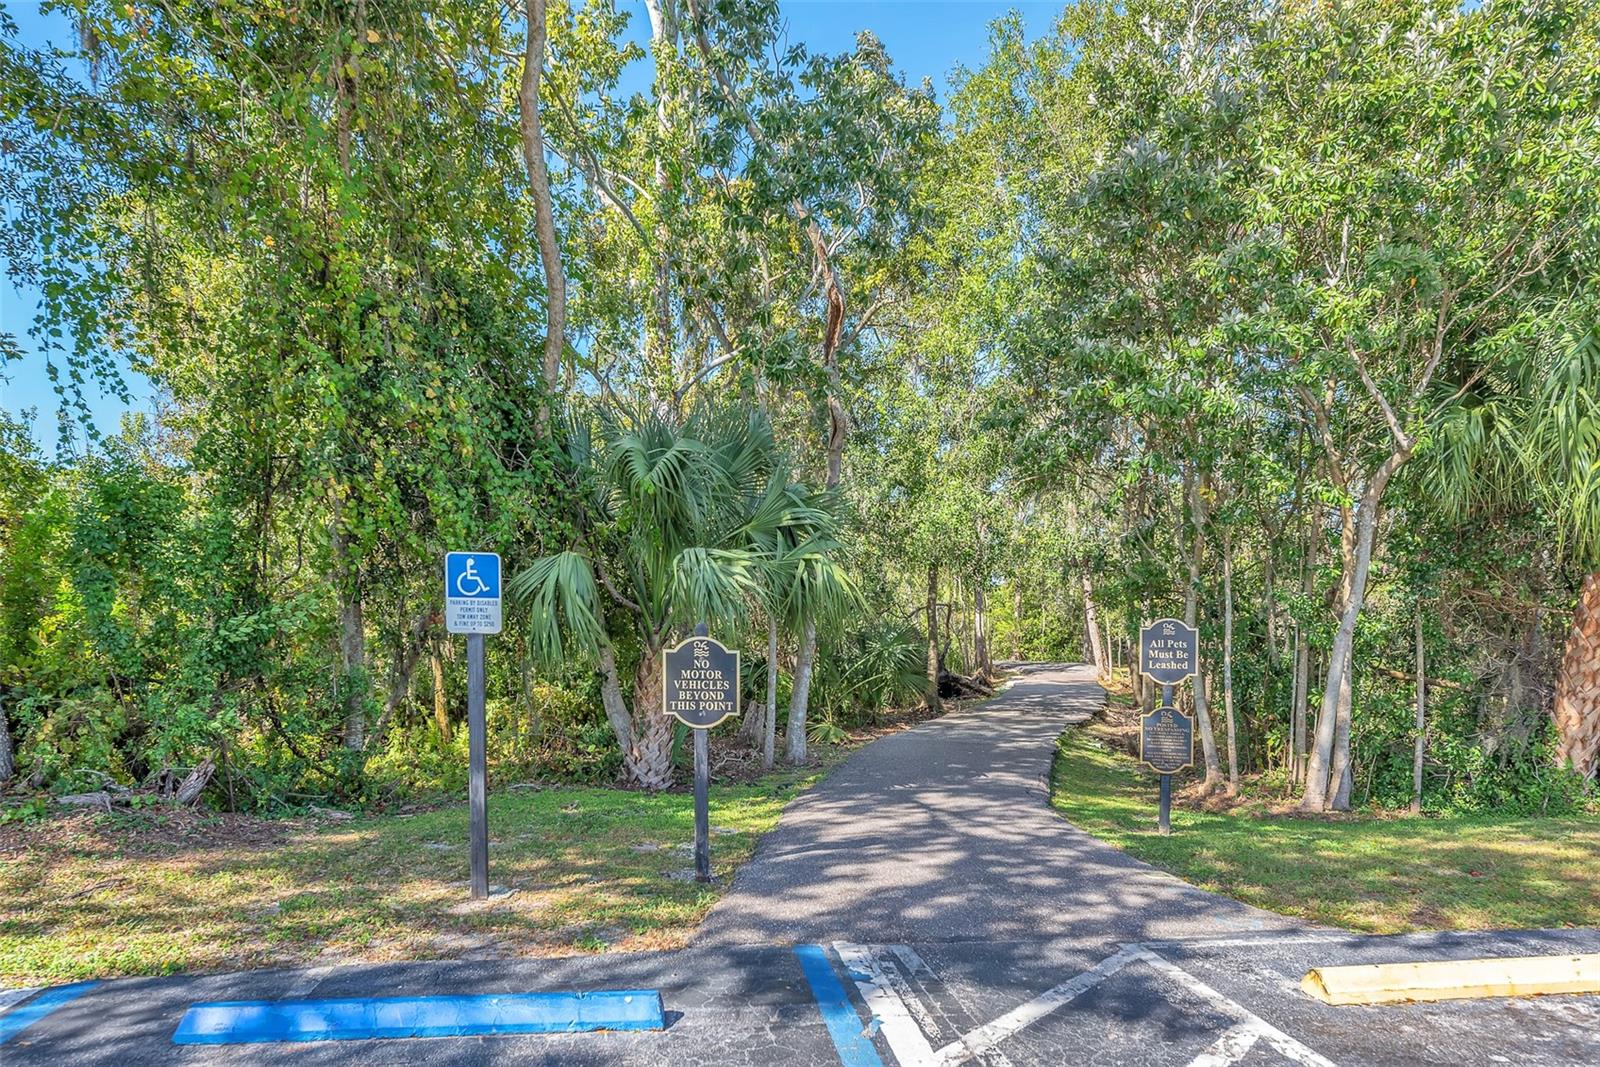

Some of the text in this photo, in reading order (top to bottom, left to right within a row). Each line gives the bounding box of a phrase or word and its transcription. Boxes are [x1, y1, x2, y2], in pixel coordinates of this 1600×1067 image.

[1150, 640, 1188, 648] All Pets
[1148, 650, 1189, 659] Must Be
[694, 659, 710, 669] NO
[1149, 660, 1189, 669] Leashed
[681, 669, 722, 679] MOTOR
[673, 680, 730, 690] VEHICLES
[678, 690, 725, 700] BEYOND
[669, 701, 733, 711] THIS POINT
